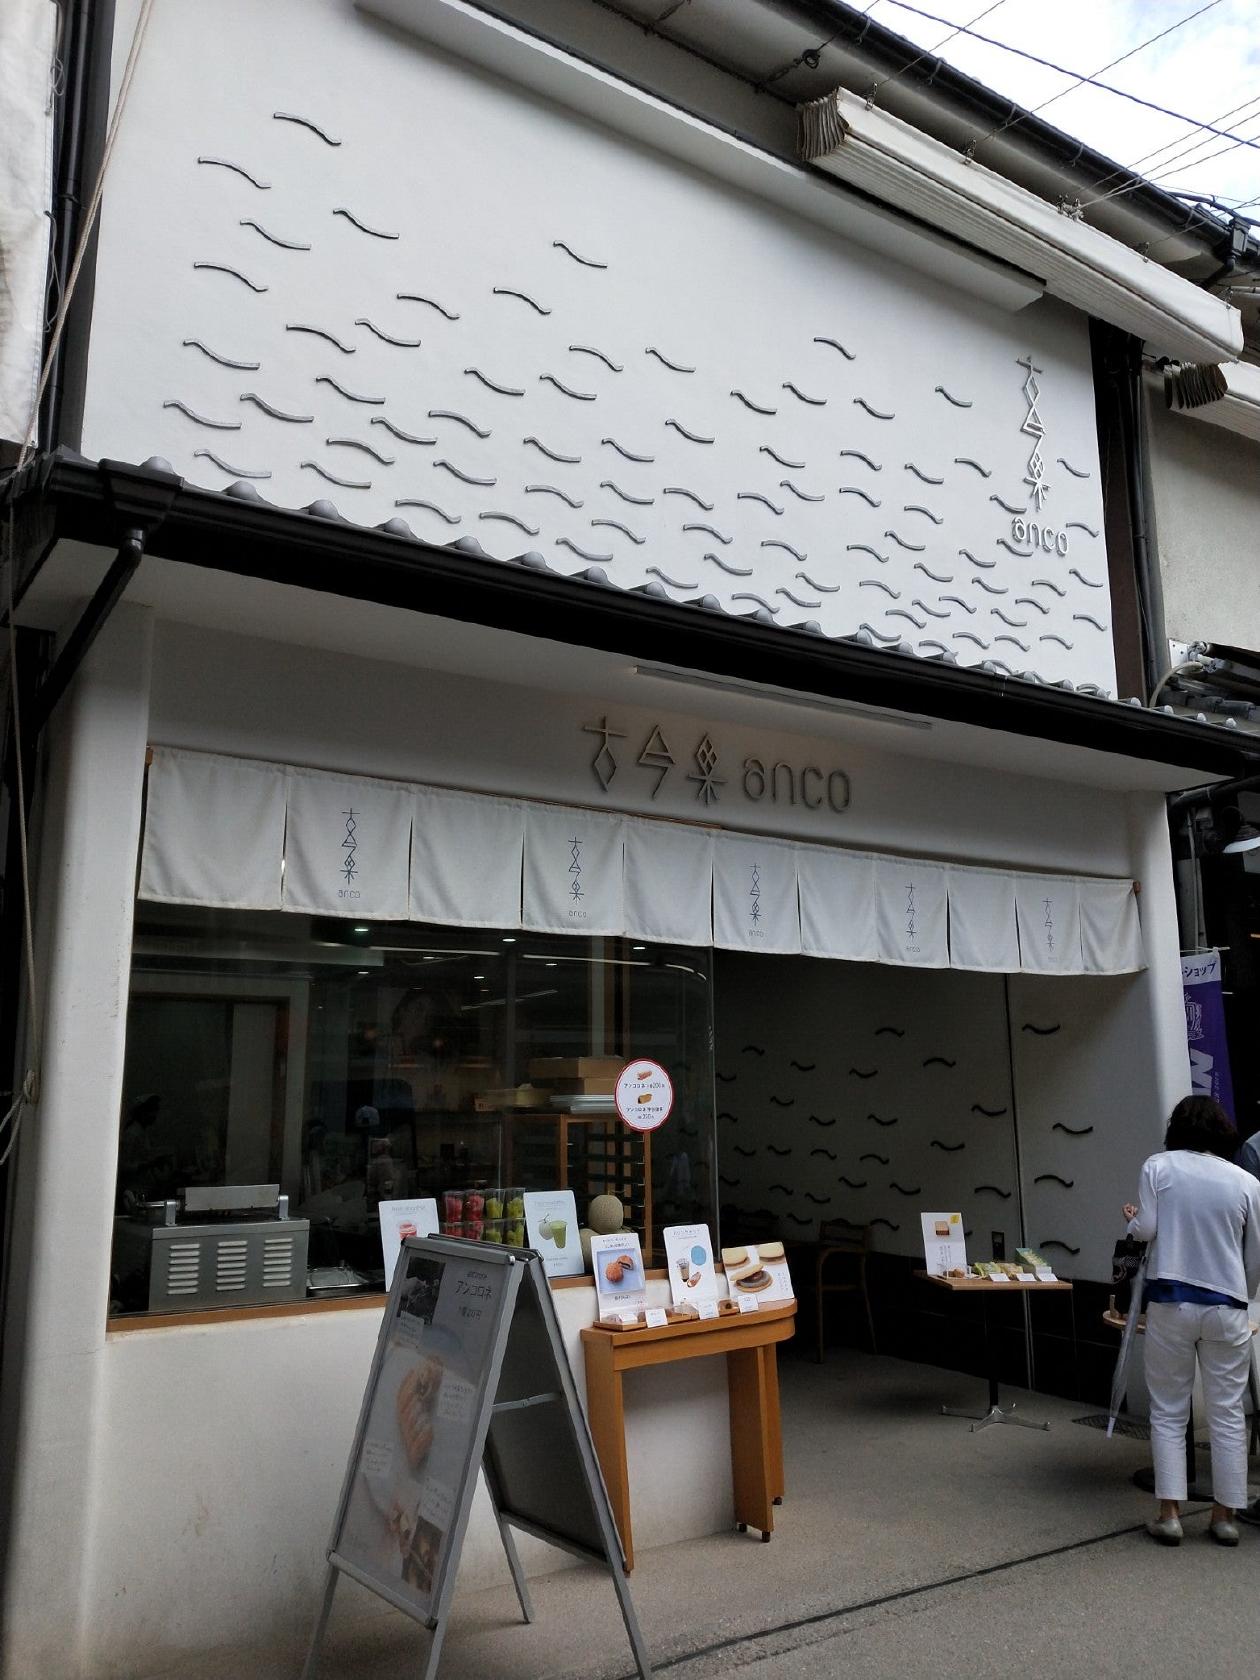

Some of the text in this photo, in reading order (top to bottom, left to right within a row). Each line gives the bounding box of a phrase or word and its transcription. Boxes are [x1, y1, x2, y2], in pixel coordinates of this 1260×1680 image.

[1182, 961, 1217, 978] ショップ
[455, 1280, 493, 1301] アンコロネ
